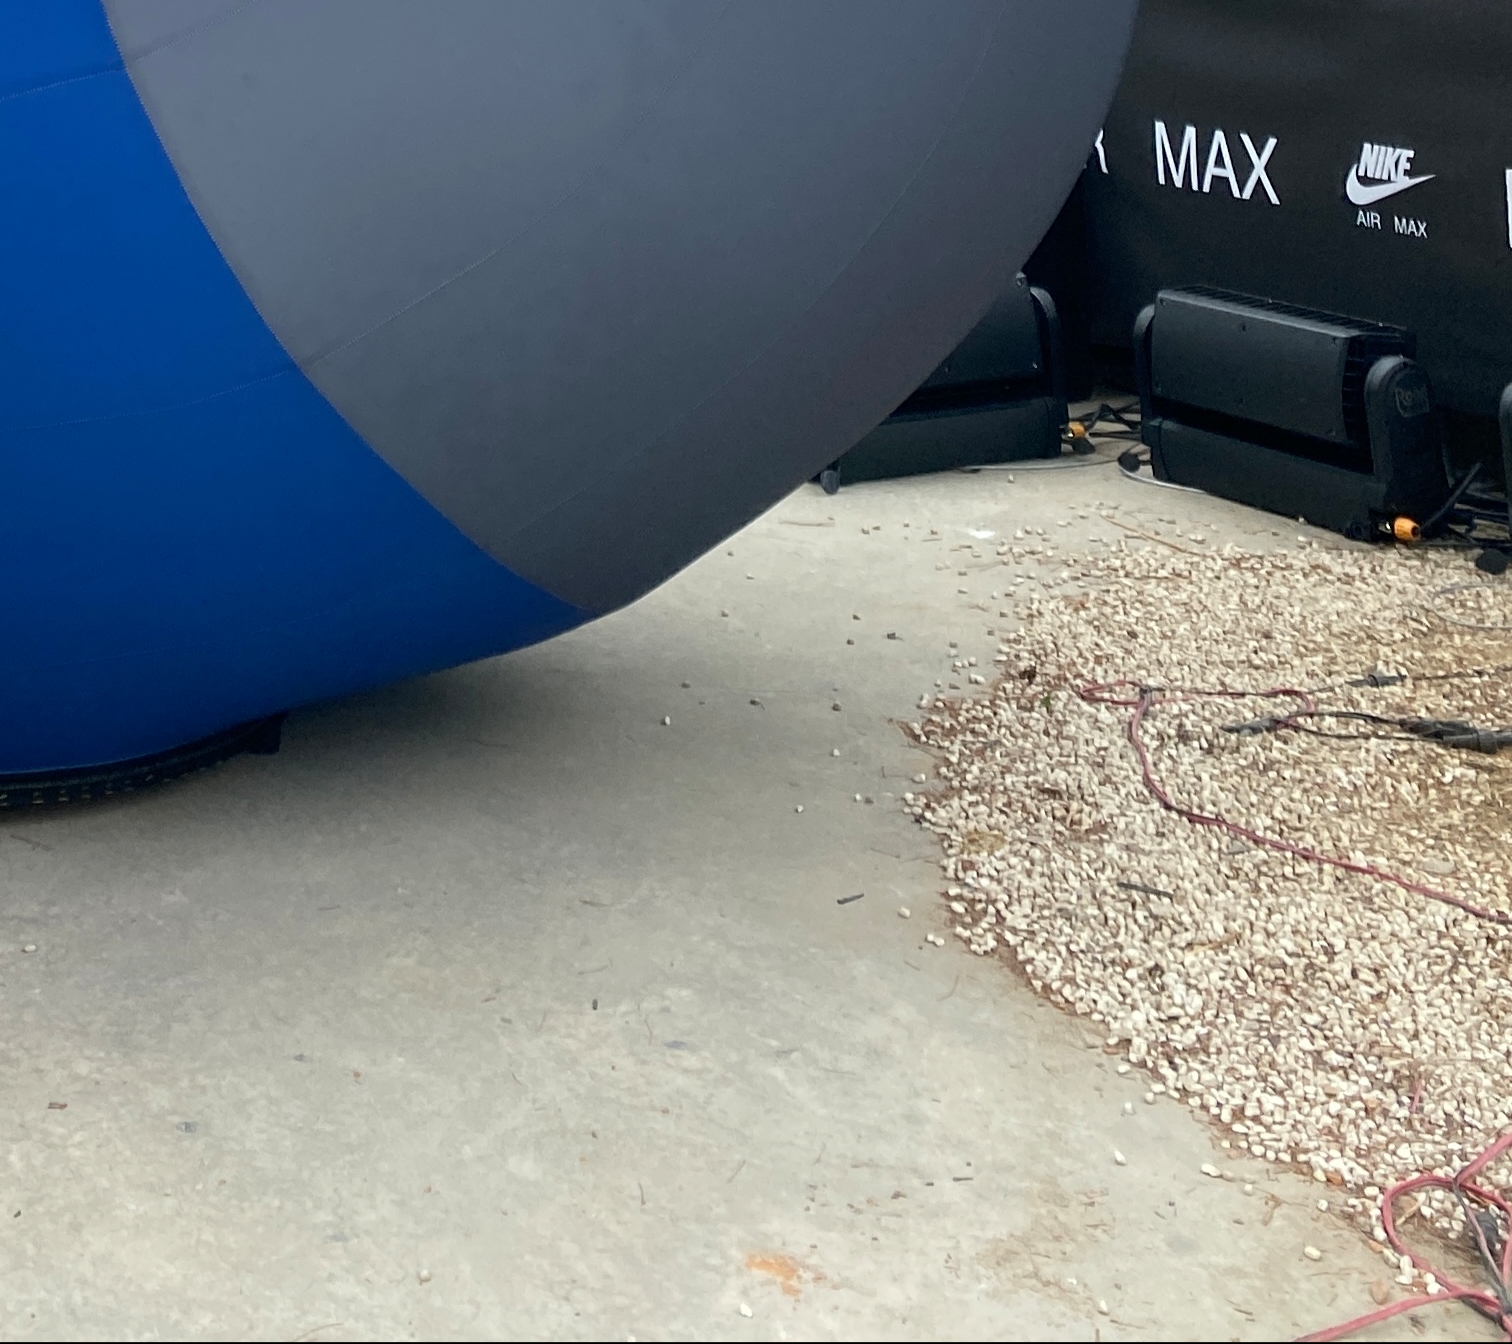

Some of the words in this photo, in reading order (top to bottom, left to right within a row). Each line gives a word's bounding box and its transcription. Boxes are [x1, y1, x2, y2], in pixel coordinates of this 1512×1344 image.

[1154, 119, 1281, 205] MAX
[1357, 142, 1415, 182] NIKE
[1356, 210, 1382, 230] AIR
[1394, 216, 1428, 239] MAX
